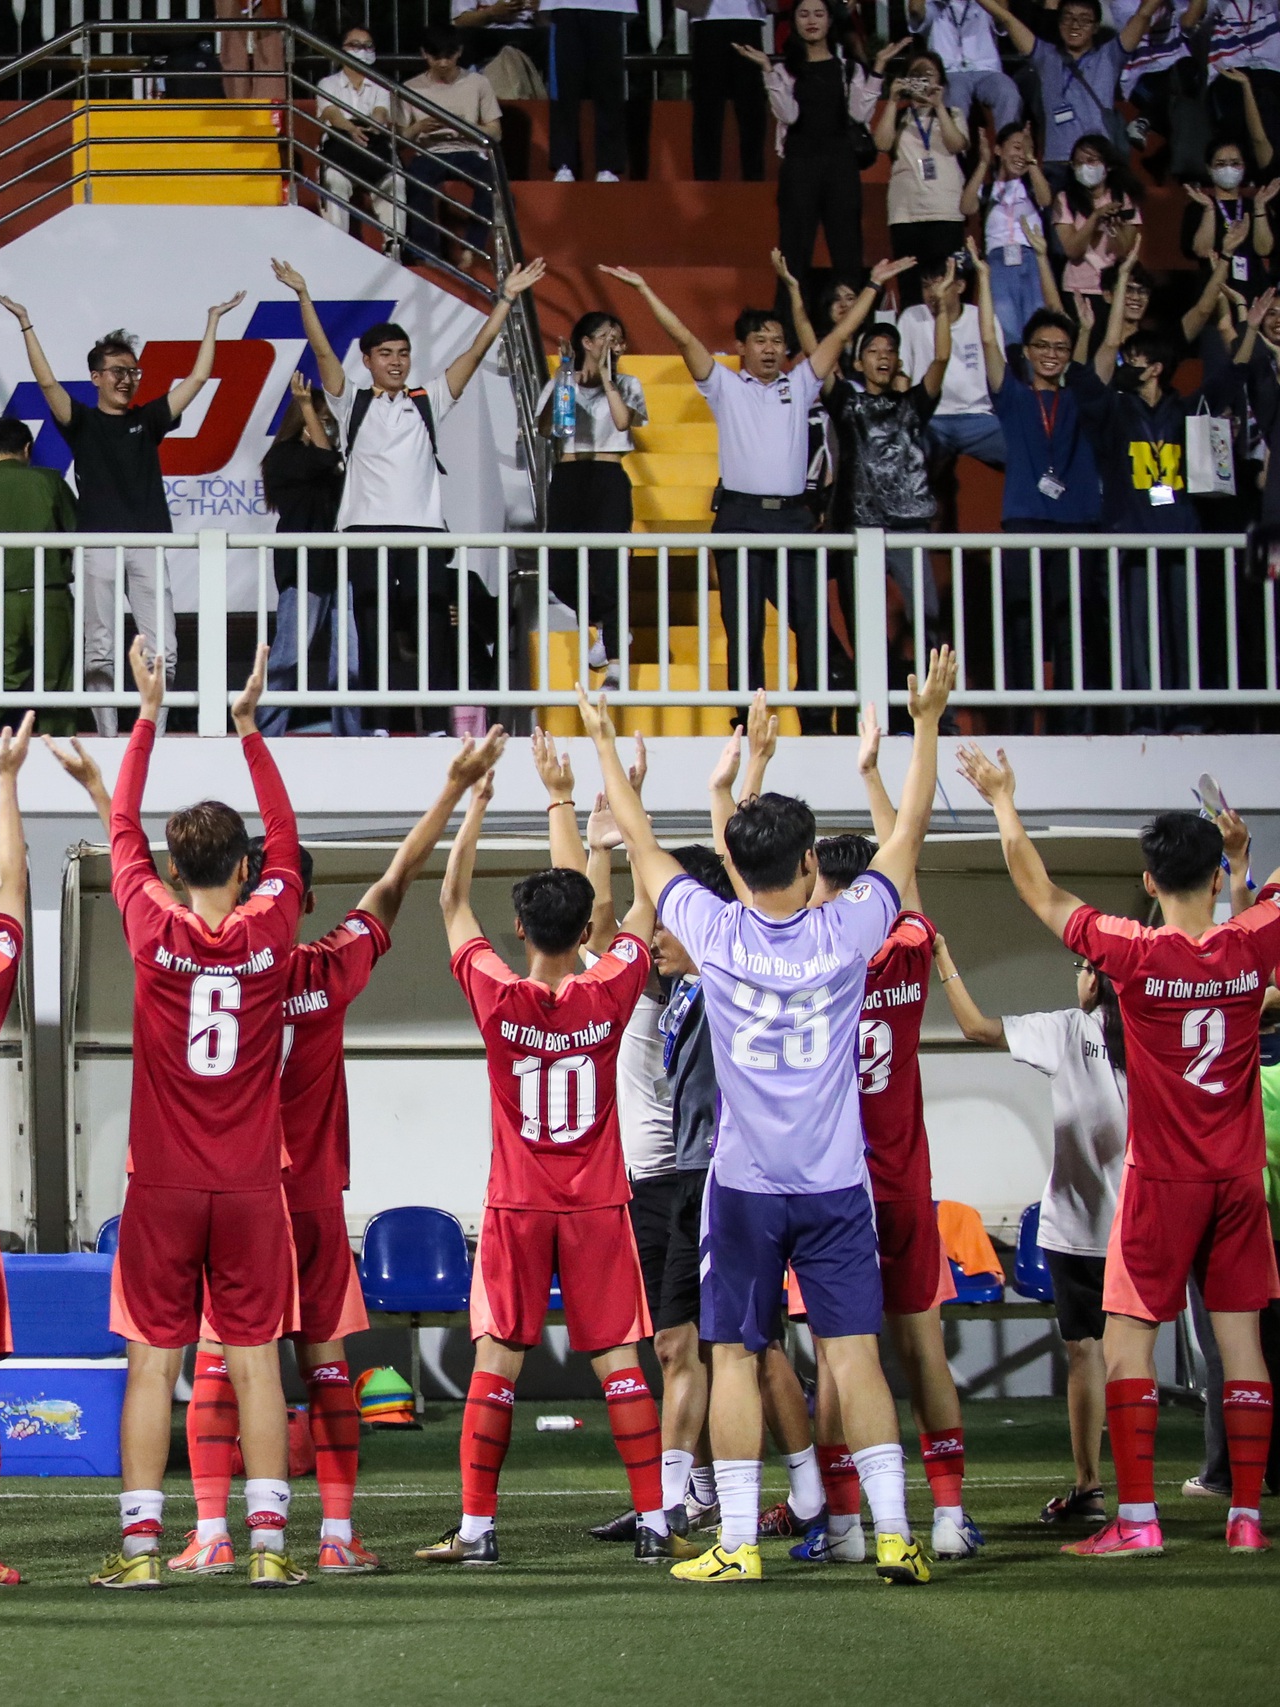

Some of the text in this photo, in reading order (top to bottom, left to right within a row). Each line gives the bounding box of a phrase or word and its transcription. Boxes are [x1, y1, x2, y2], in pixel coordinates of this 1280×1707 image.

[196, 476, 245, 498] TÔN
[155, 946, 171, 967] ĐH
[747, 952, 772, 976] TÔN
[883, 980, 921, 1007] THẮNG
[1145, 970, 1259, 998] ĐH TÔN ĐỨC THẮNG
[289, 989, 329, 1017] THẮNG
[188, 974, 241, 1076] 6
[501, 1020, 612, 1052] ĐH TÔN ĐỨC THẮNG
[731, 980, 834, 1070] 23
[1085, 1040, 1099, 1058] ĐH
[1182, 1007, 1228, 1095] 2
[512, 1054, 596, 1144] 10
